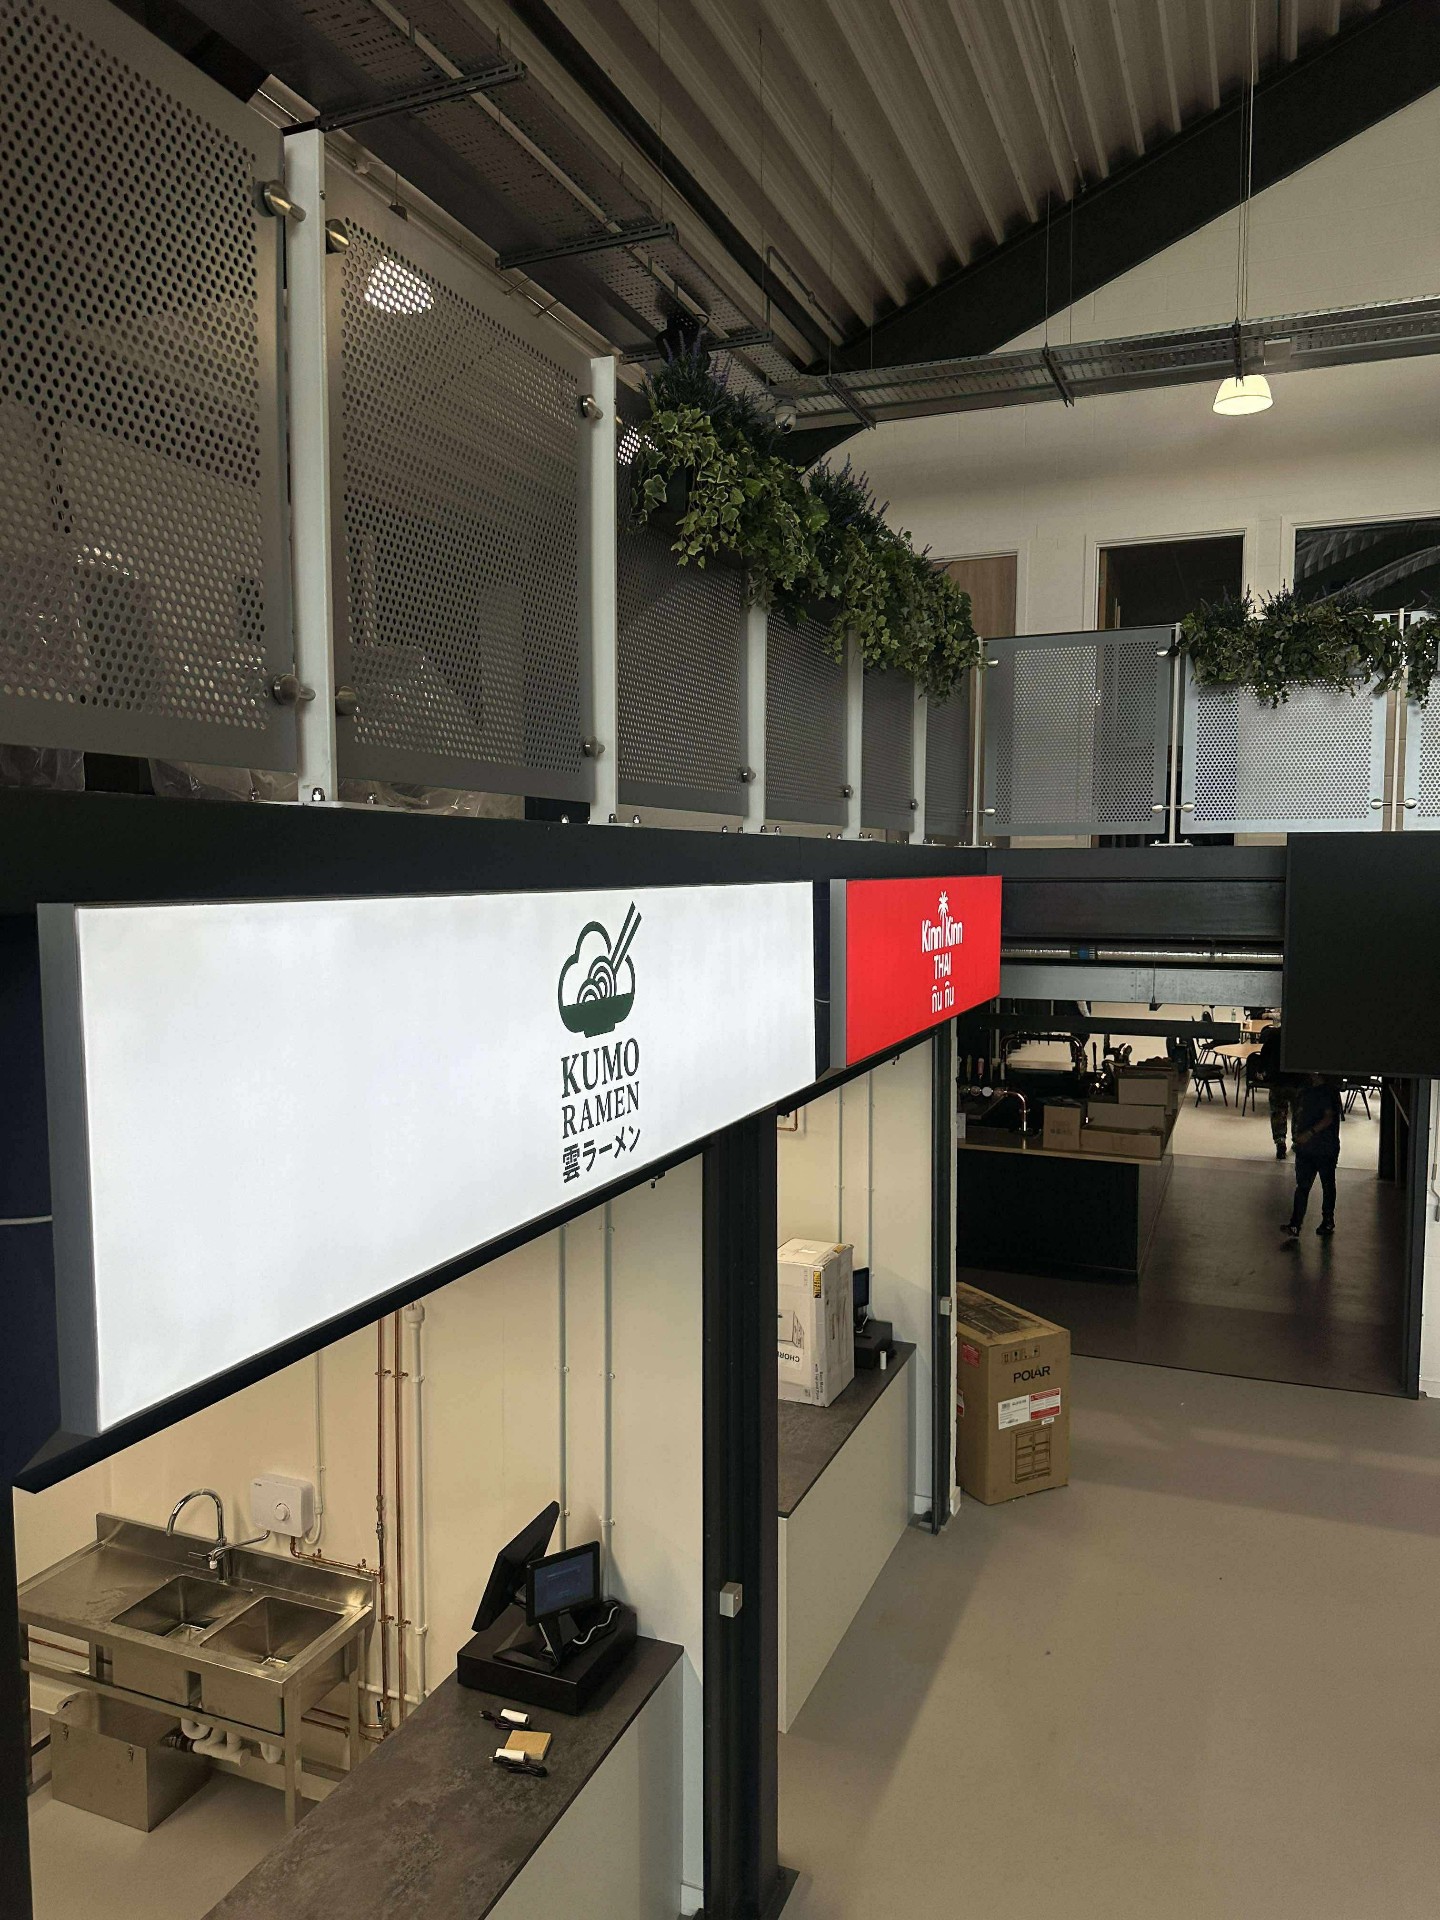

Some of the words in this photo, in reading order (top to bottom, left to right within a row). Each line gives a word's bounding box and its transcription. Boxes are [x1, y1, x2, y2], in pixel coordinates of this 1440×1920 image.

[933, 951, 952, 980] THAI
[560, 1037, 640, 1099] KUMO
[561, 1081, 640, 1139] RAMEN
[562, 1125, 641, 1184] 雲ラーメン
[777, 1350, 800, 1363] CHOR
[1013, 1365, 1051, 1383] POLAR
